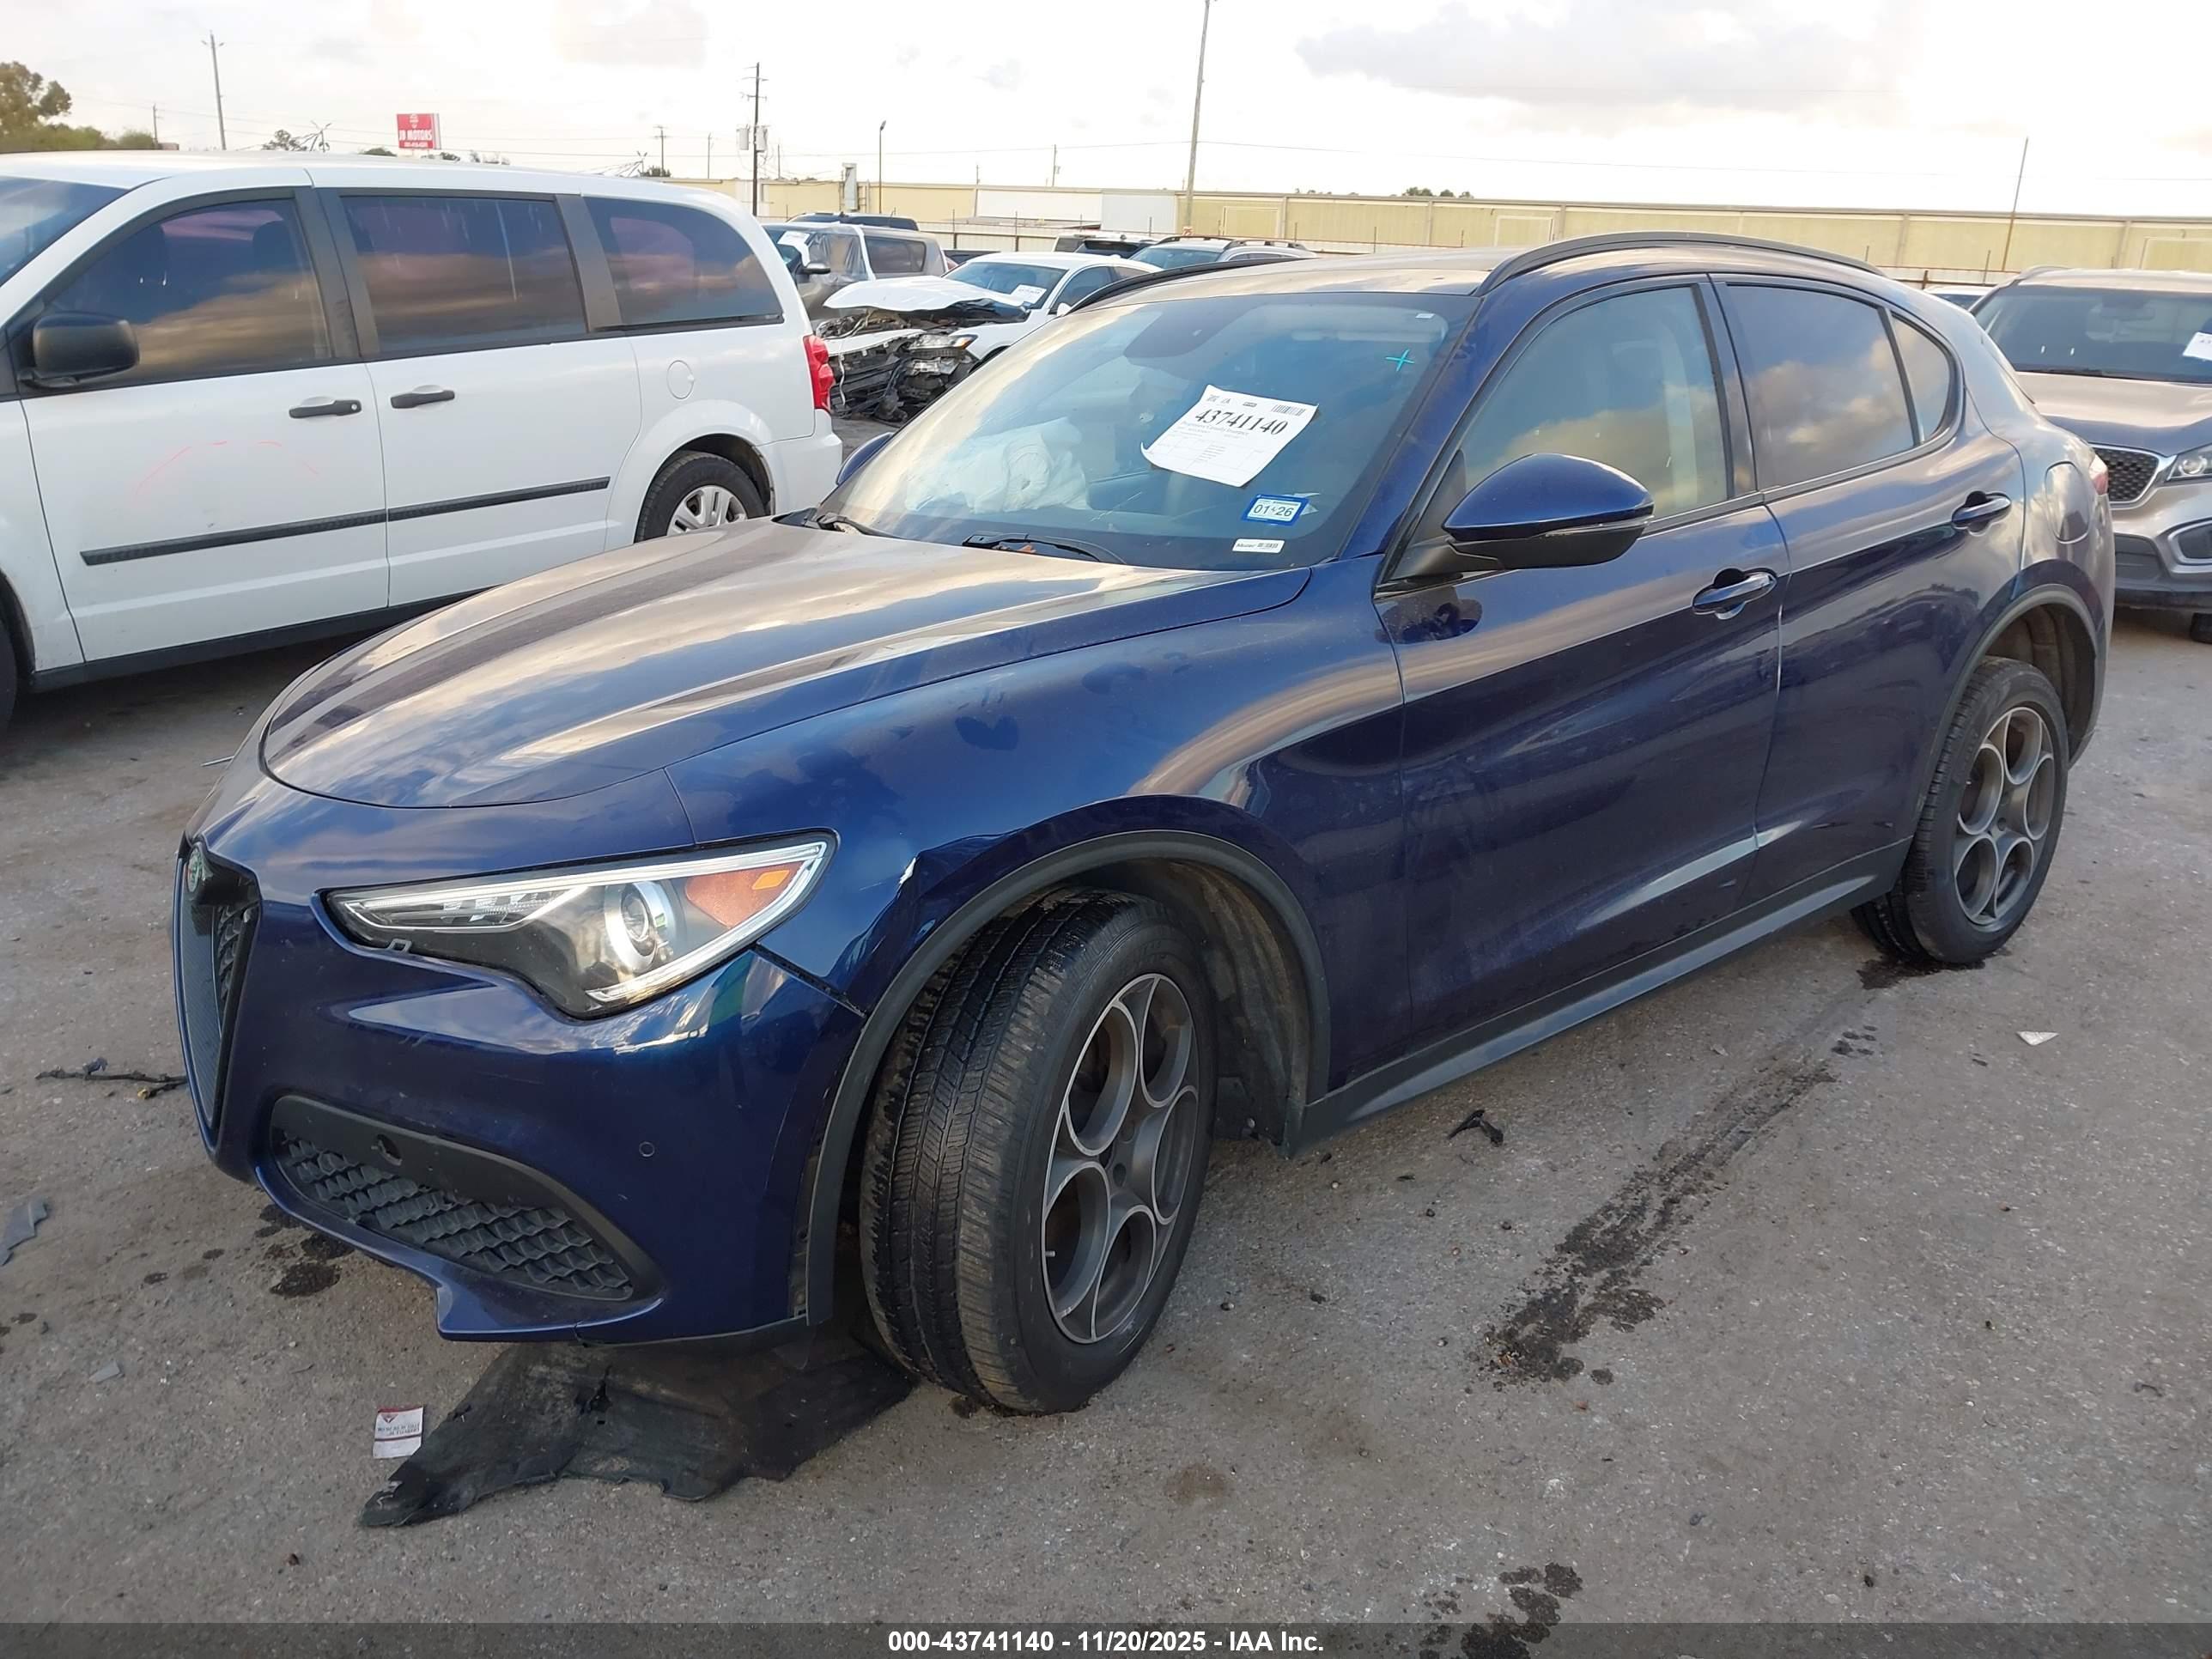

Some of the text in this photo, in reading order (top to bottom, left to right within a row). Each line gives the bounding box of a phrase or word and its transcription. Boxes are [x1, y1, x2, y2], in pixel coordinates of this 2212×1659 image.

[1194, 408, 1289, 435] 43741140
[1254, 504, 1294, 517] 01 26
